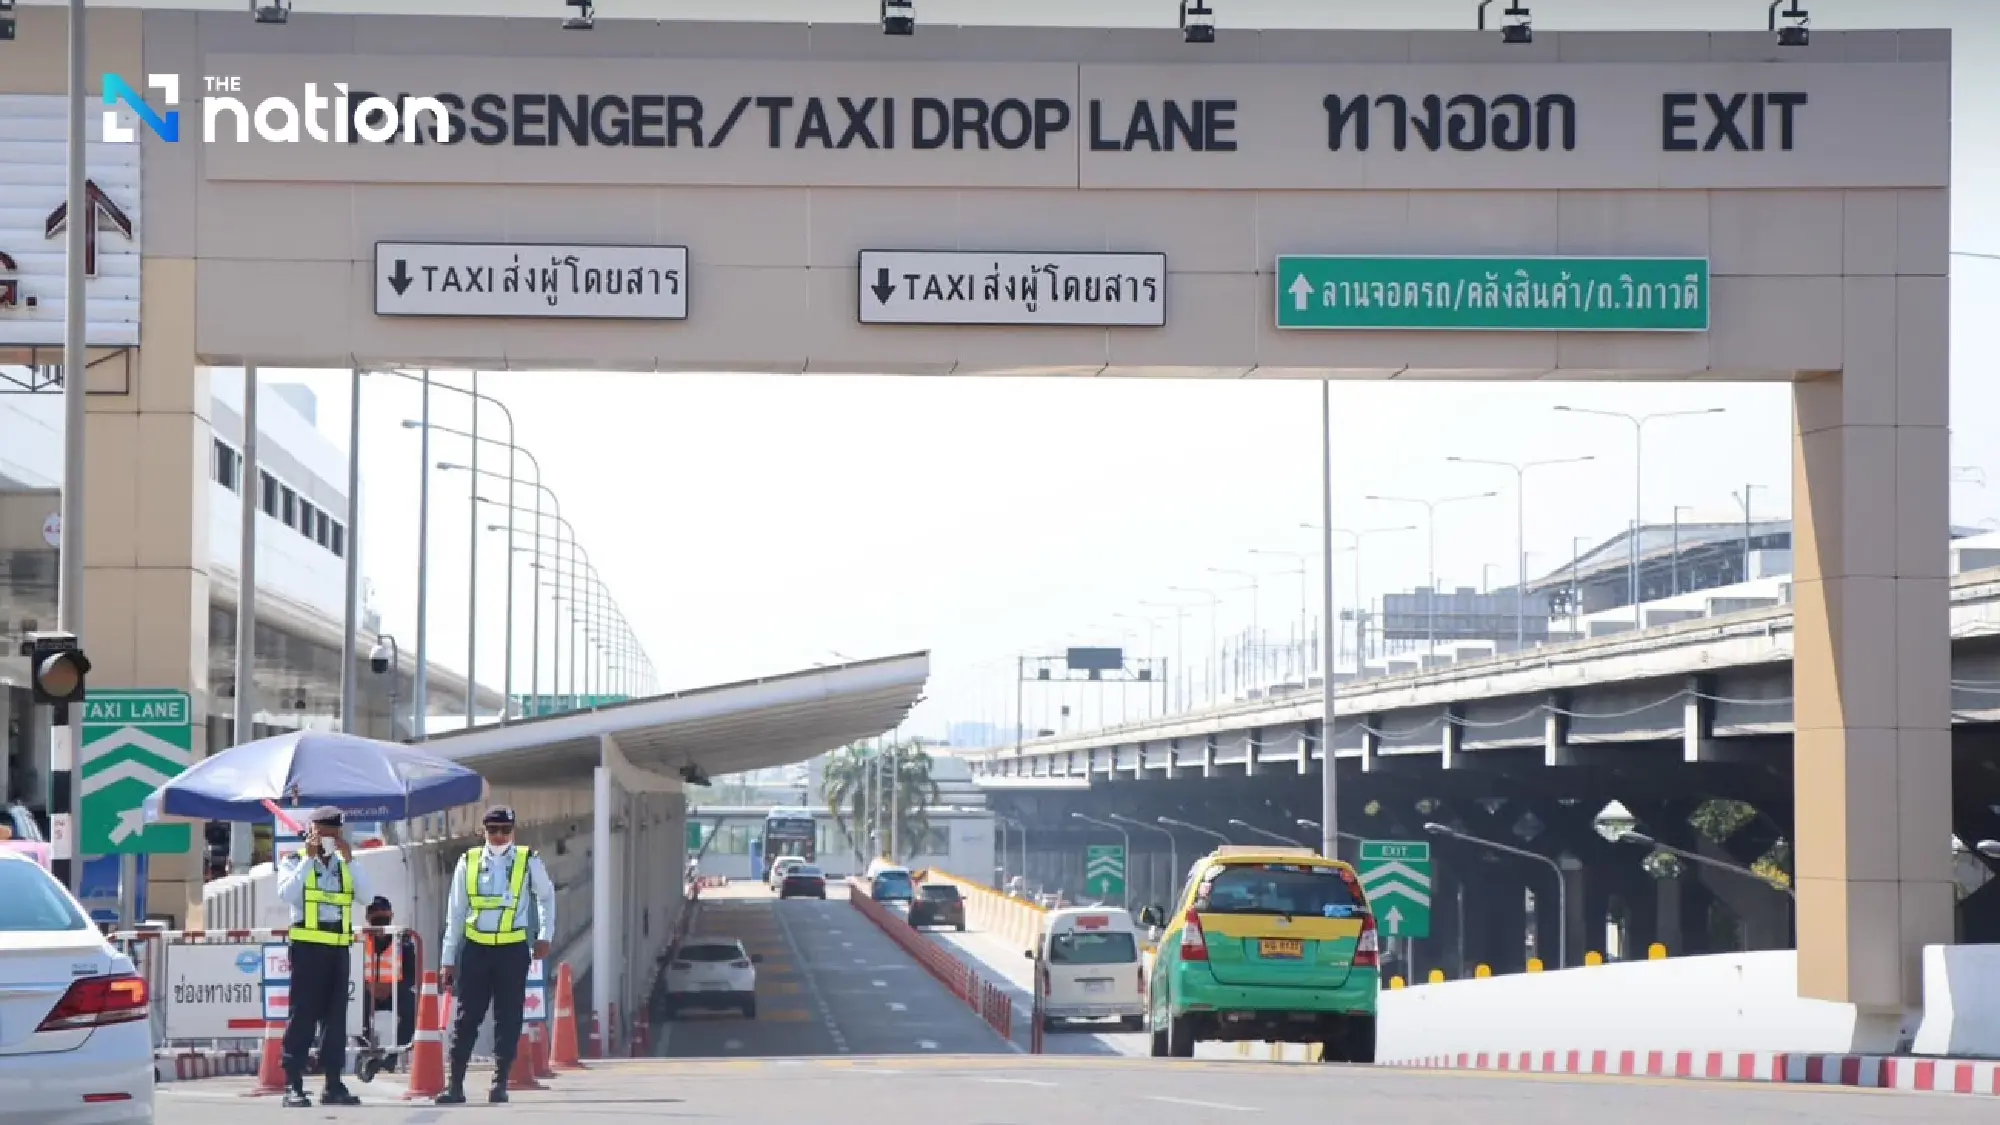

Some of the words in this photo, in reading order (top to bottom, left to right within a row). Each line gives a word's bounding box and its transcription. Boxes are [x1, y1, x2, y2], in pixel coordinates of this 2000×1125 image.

[911, 97, 1070, 151] DROP
[1090, 99, 1238, 152] LANE
[1322, 93, 1576, 151] ทางออก
[1662, 92, 1807, 151] EXIT
[421, 265, 494, 293] TAXI
[503, 253, 679, 306] ส่งผู้โดยสาร
[902, 273, 975, 301] TAXI
[984, 262, 1157, 313] ส่งผู้โดยสาร
[82, 702, 121, 718] TAXI
[130, 702, 180, 718] LANE
[1382, 845, 1408, 857] EXIT
[174, 973, 252, 1004] ช่องทางรถ
[266, 955, 292, 973] Ta
